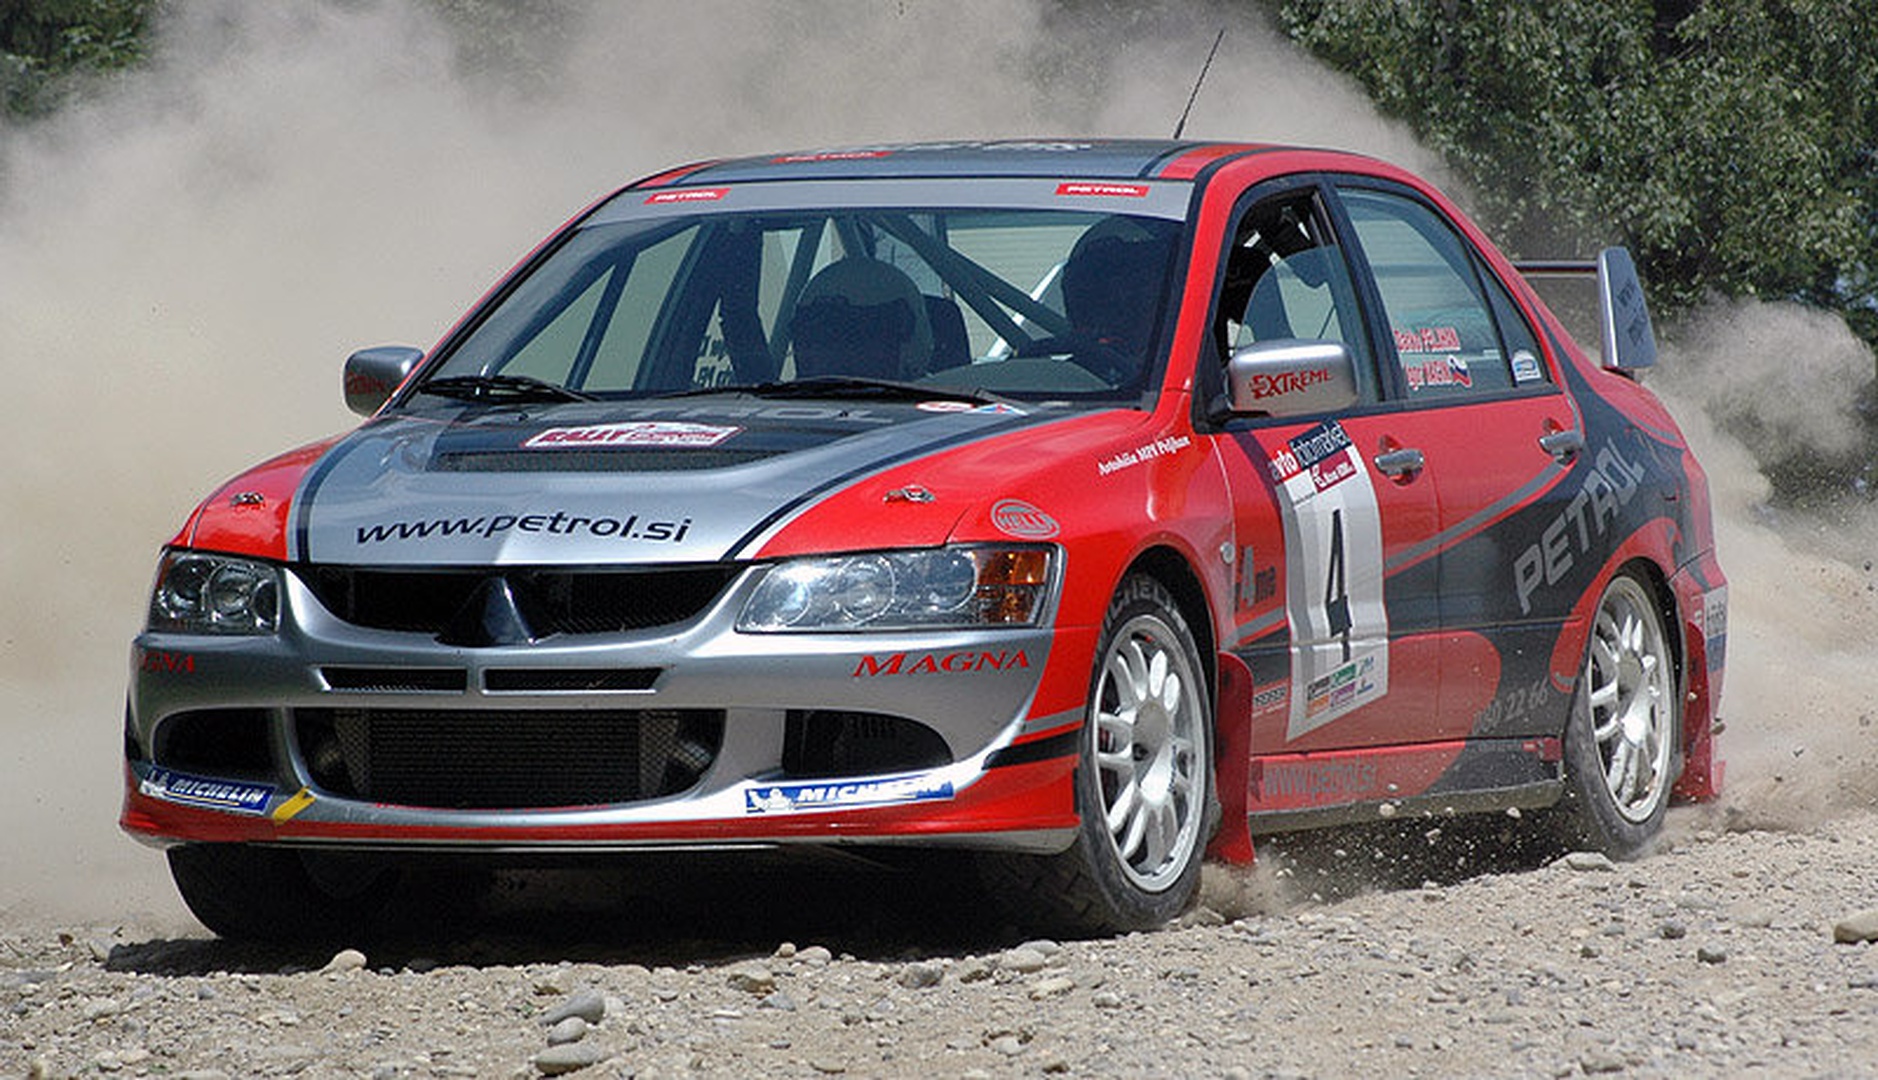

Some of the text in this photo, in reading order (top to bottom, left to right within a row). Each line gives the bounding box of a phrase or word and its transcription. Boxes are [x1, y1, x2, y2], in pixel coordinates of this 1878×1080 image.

[1067, 185, 1140, 195] PETROL
[1249, 367, 1334, 400] EXTREME
[356, 511, 692, 544] www.petrol.si
[1513, 435, 1647, 616] PETROL
[1326, 508, 1353, 664] 4
[852, 648, 1031, 678] MAGNA
[170, 778, 267, 804] MICHELIN
